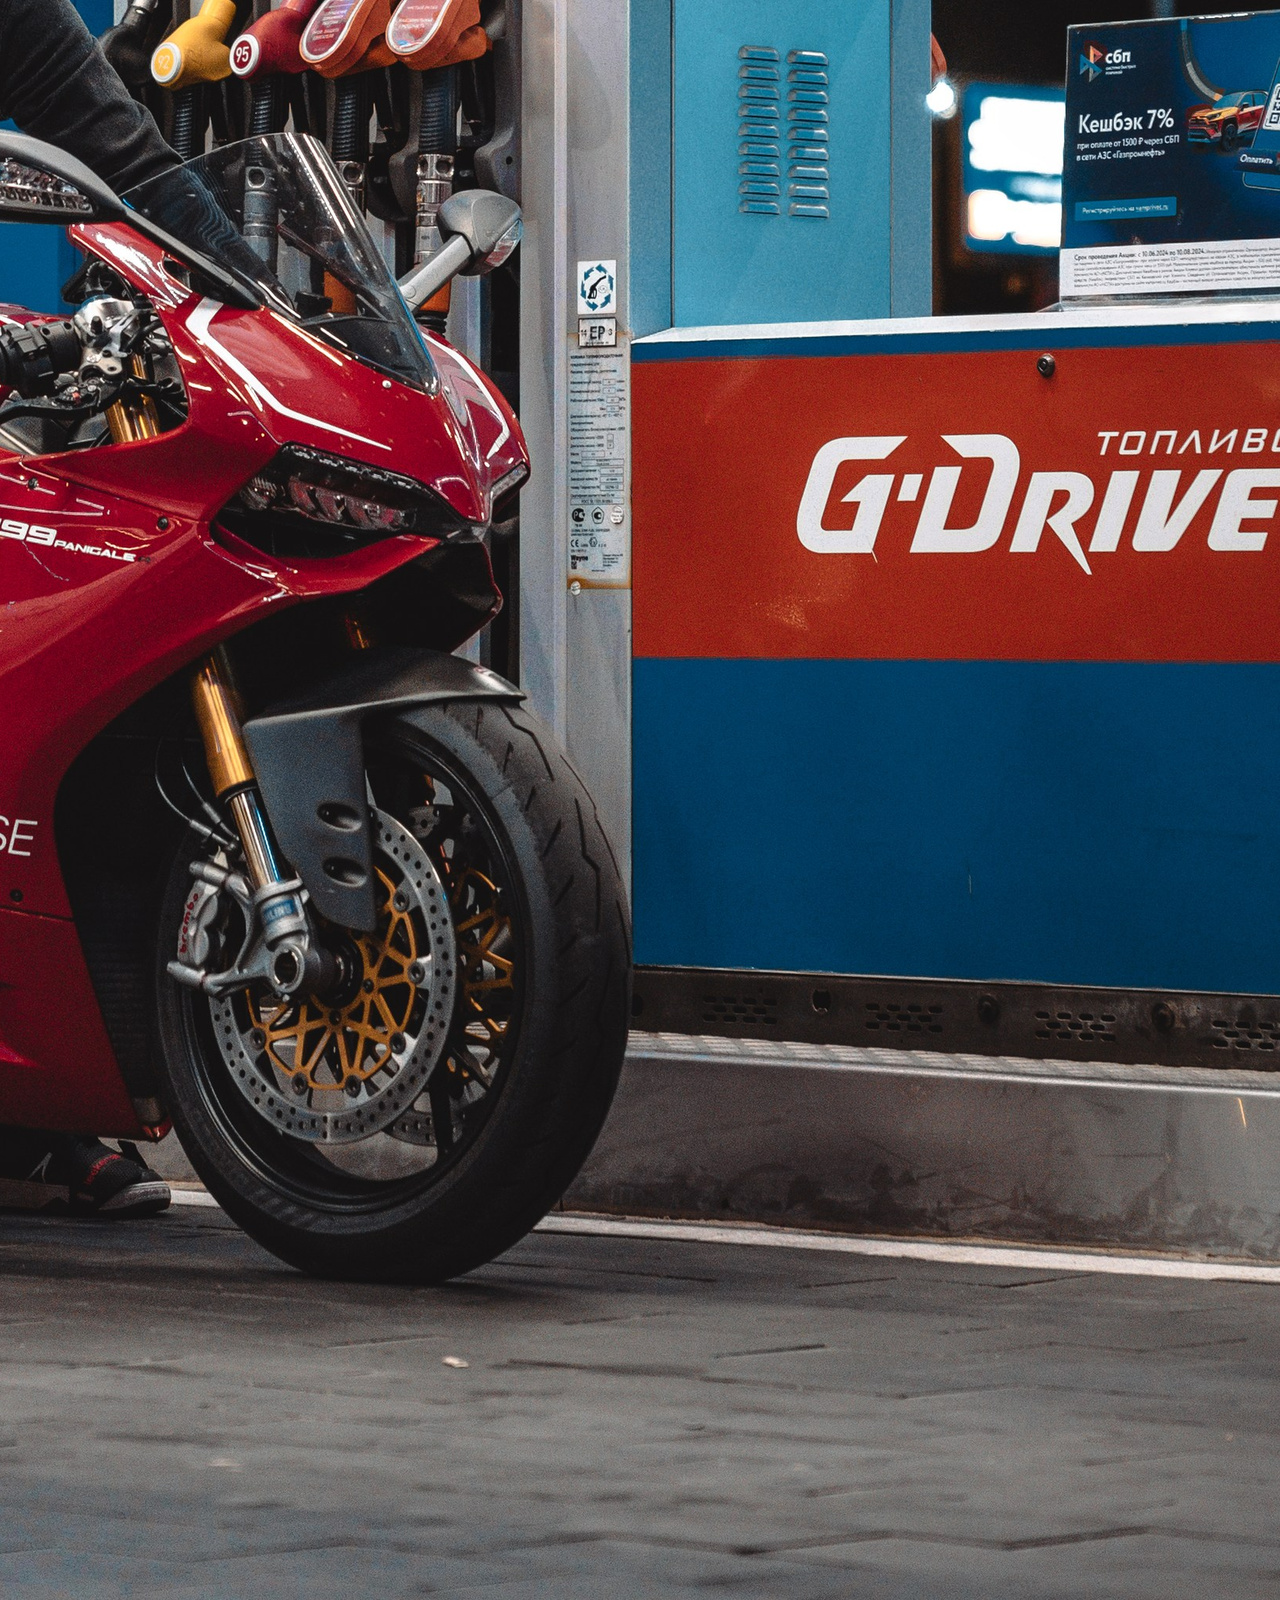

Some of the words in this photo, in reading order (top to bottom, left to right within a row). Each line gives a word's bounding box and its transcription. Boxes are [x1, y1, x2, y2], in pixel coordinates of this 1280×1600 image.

[157, 55, 170, 70] 92
[236, 46, 249, 63] 95
[1105, 49, 1131, 64] сбп
[1079, 112, 1143, 133] Кешбэк
[1147, 108, 1174, 129] 7%
[1077, 143, 1090, 151] при
[1090, 140, 1112, 149] оплате
[1122, 138, 1137, 147] 1500
[1144, 138, 1163, 146] через
[1164, 135, 1180, 144] СБП
[1081, 153, 1096, 161] сети
[1097, 151, 1112, 160] АЗС
[1240, 154, 1273, 165] Оплатить
[54, 540, 136, 562] PANIGALE
[180, 893, 198, 953] brembo
